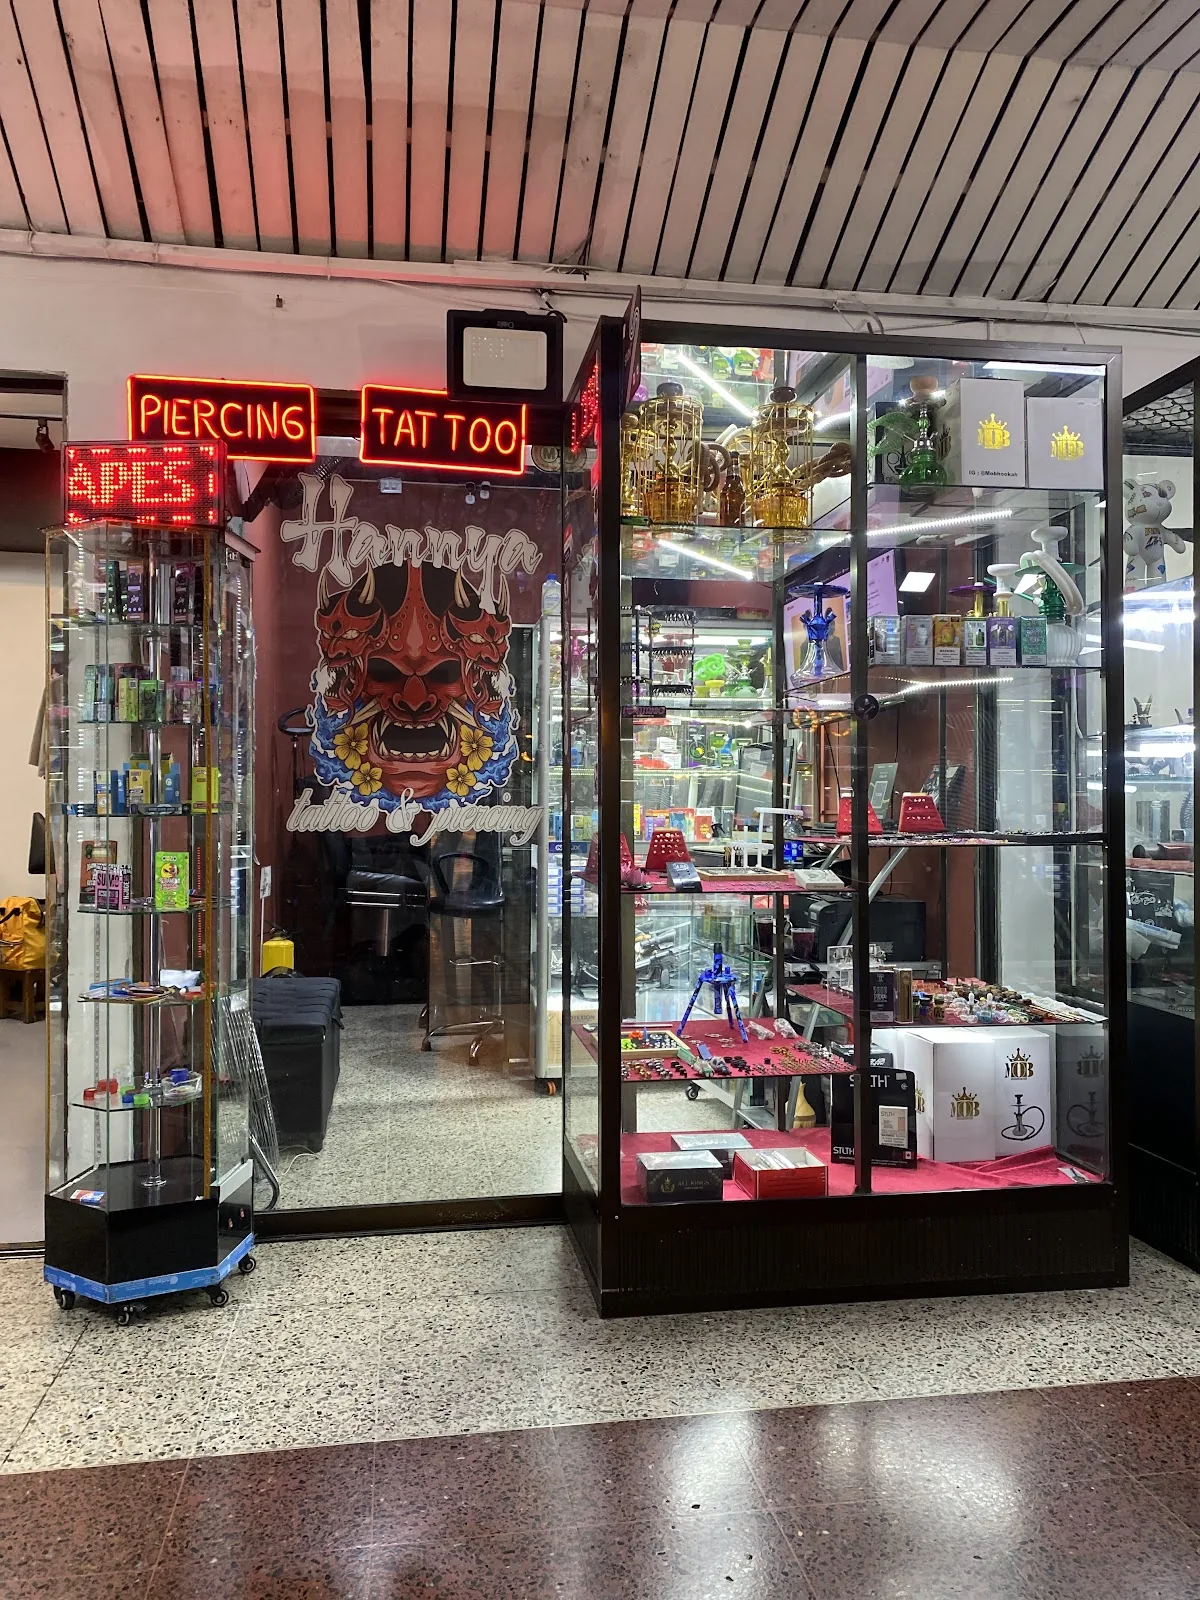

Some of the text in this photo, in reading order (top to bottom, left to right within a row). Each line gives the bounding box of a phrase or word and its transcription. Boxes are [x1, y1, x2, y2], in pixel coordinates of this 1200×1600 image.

[140, 394, 305, 440] PIERCING
[280, 471, 543, 613] Hannya
[286, 787, 545, 847] tattoo & piercing
[1004, 1062, 1034, 1078] MOB
[848, 1074, 889, 1088] STH
[950, 1101, 980, 1117] MOB
[832, 1146, 855, 1156] STLTH
